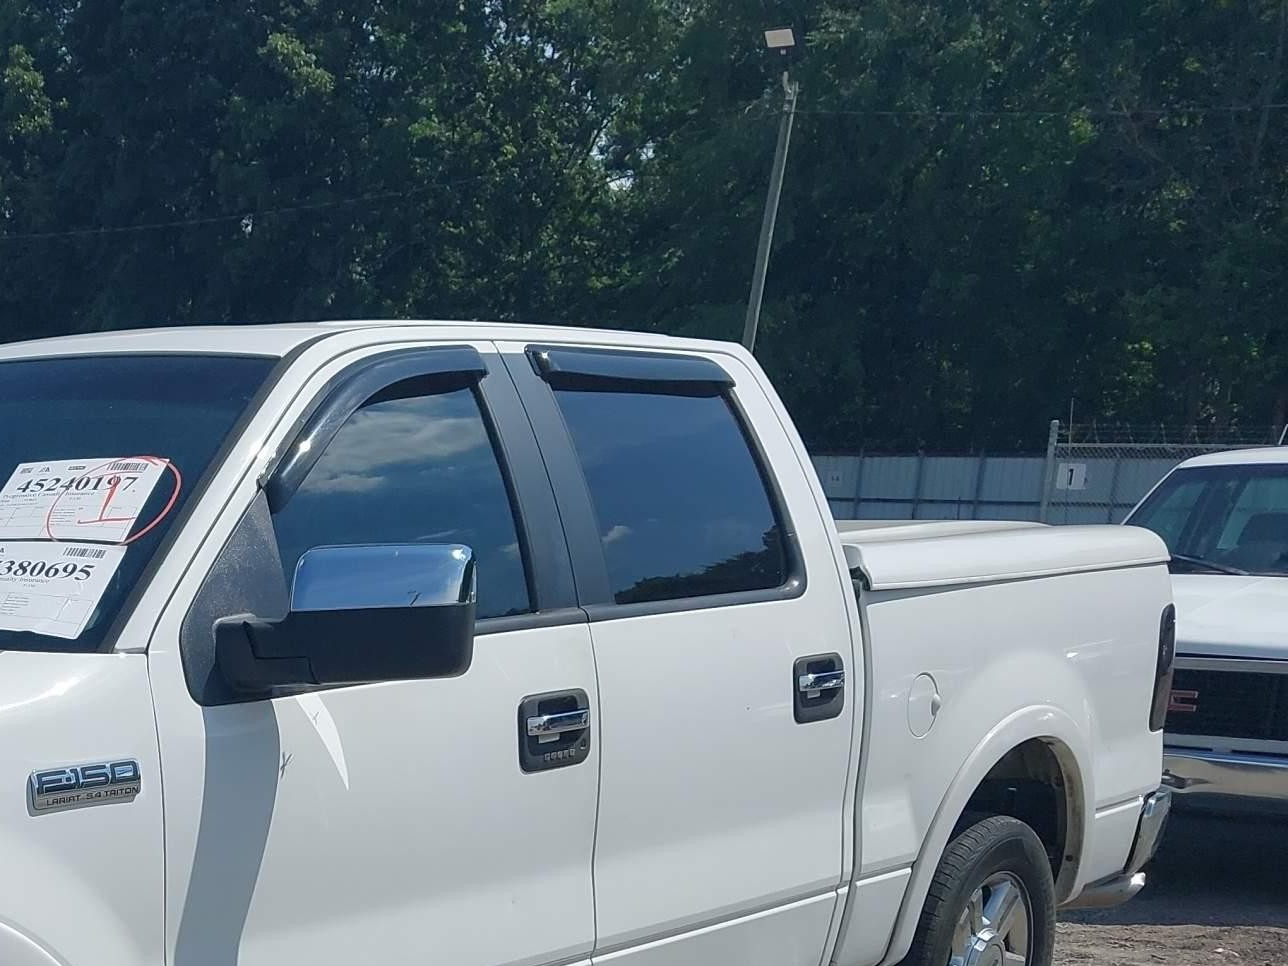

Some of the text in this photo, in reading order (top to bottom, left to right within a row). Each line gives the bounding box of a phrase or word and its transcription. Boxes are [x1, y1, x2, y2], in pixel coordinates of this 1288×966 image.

[17, 474, 138, 493] 45240197
[46, 794, 81, 806] LARIAT
[104, 786, 139, 798] TRITON
